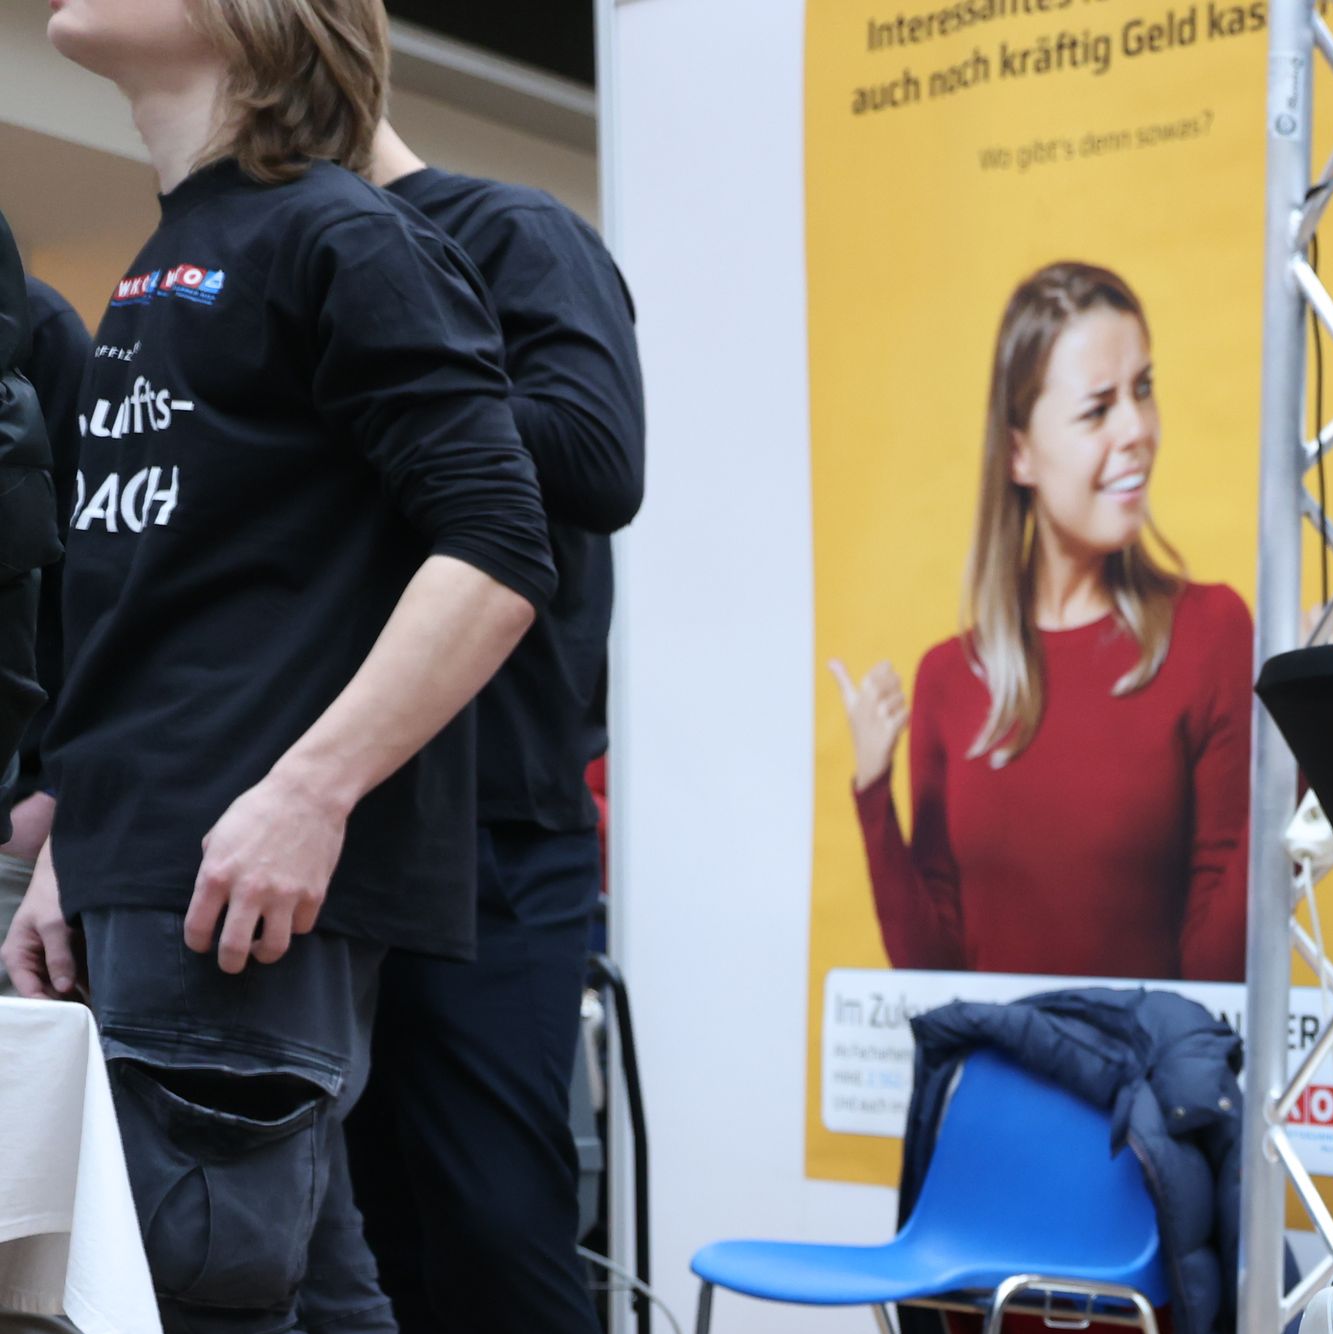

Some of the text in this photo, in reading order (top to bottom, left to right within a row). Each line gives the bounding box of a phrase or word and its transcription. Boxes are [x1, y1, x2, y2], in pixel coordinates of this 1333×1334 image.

[851, 68, 921, 115] auch
[928, 47, 991, 97] noch
[999, 31, 1111, 77] kräftig
[1121, 7, 1198, 56] Geld
